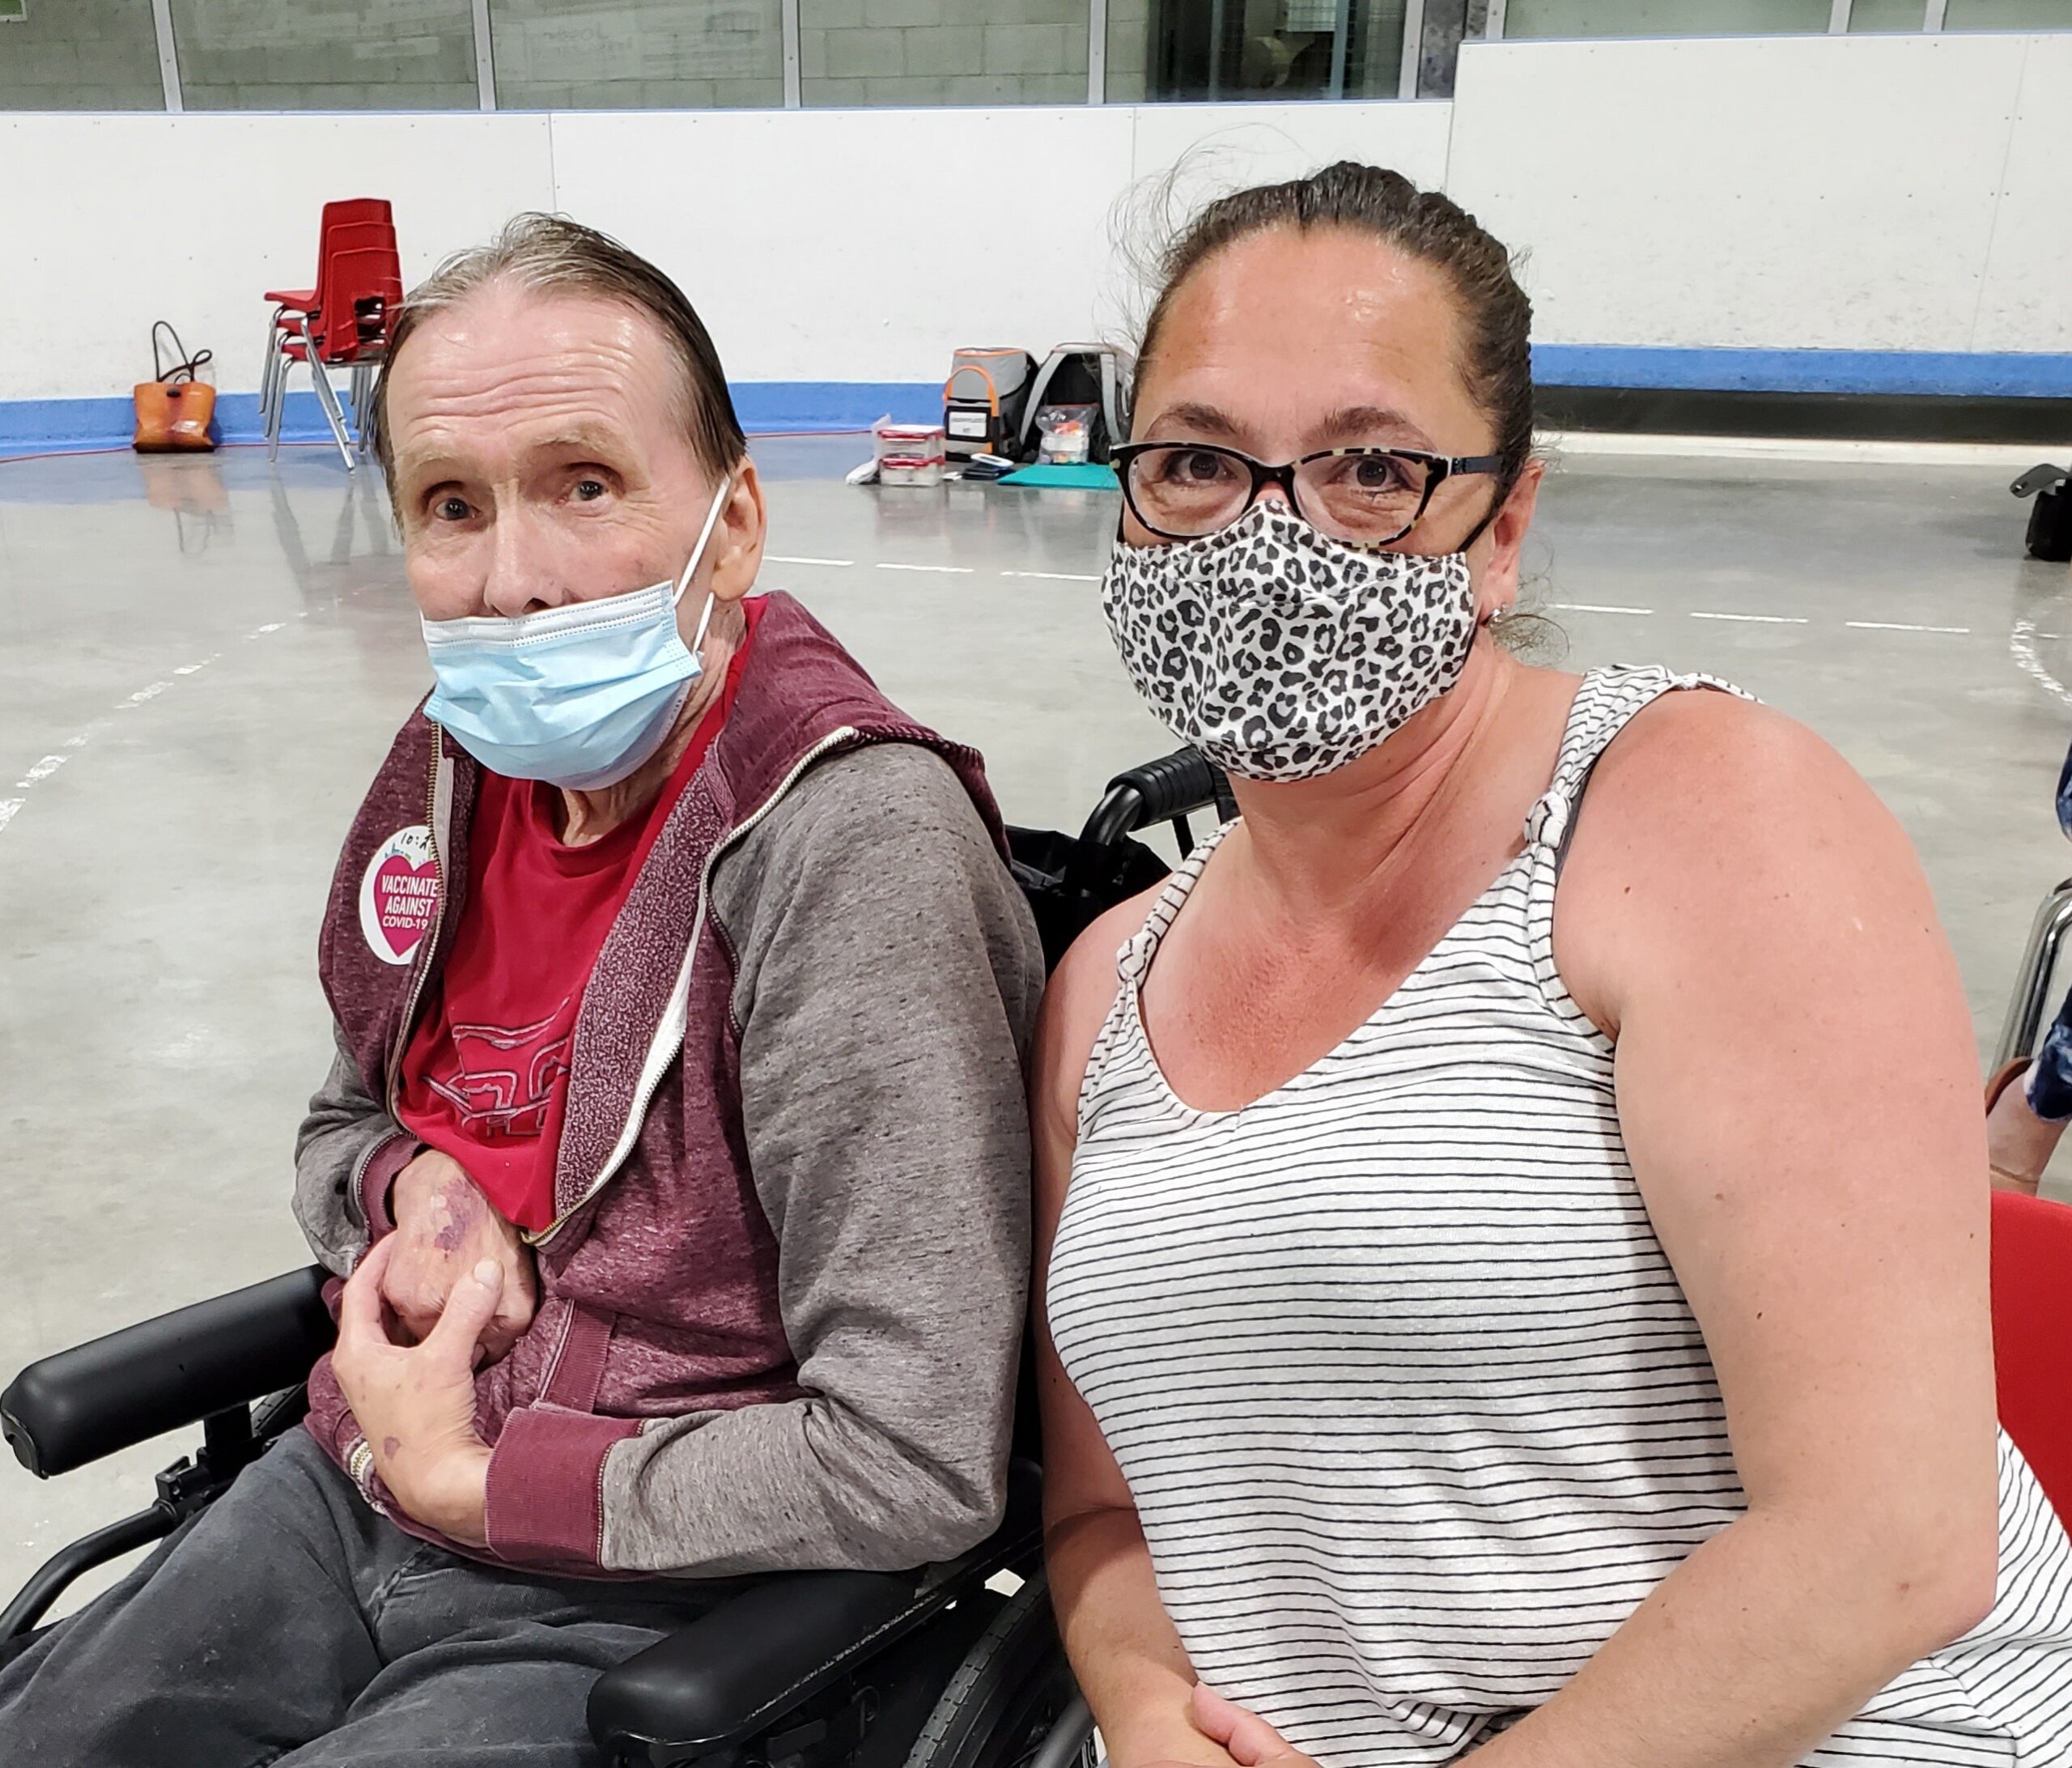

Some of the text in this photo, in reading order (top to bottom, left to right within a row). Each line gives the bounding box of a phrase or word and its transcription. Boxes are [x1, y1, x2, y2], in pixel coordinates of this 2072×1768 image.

[382, 875, 439, 898] VACCINATE
[384, 896, 434, 917] AGAINST
[382, 916, 428, 930] COVID-19
